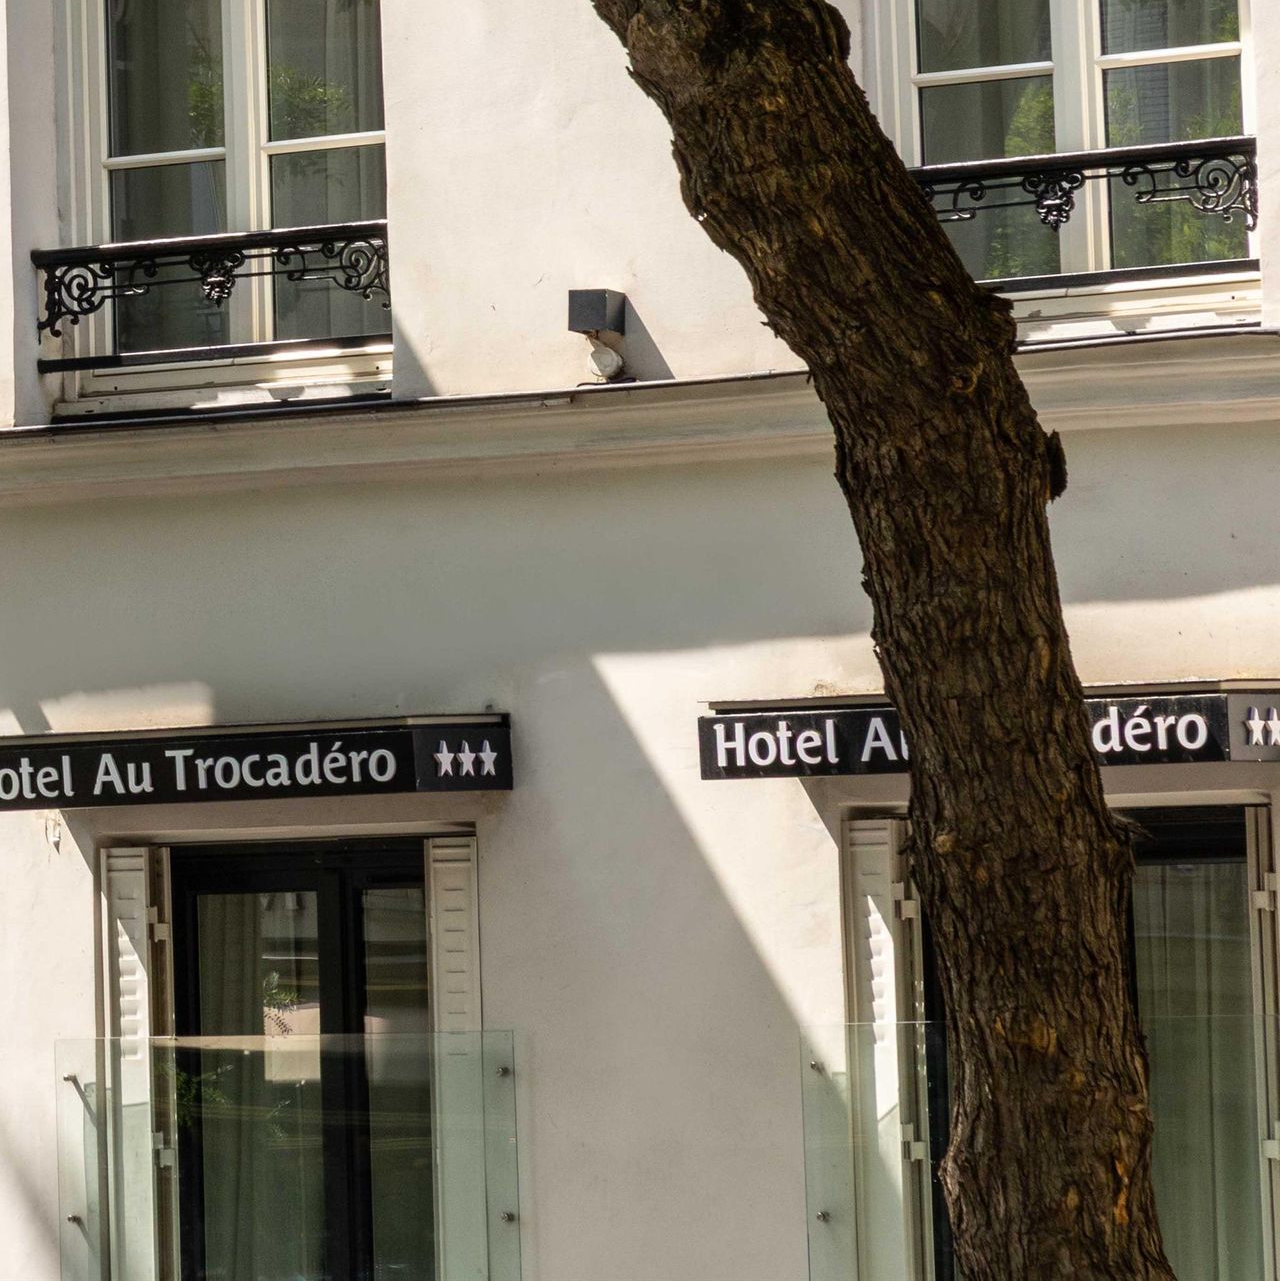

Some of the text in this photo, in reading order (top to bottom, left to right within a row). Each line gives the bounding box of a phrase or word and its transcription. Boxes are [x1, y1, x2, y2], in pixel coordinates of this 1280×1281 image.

[93, 752, 154, 796] Au
[165, 741, 397, 791] Trocadéro
[713, 717, 909, 768] Hotel A
